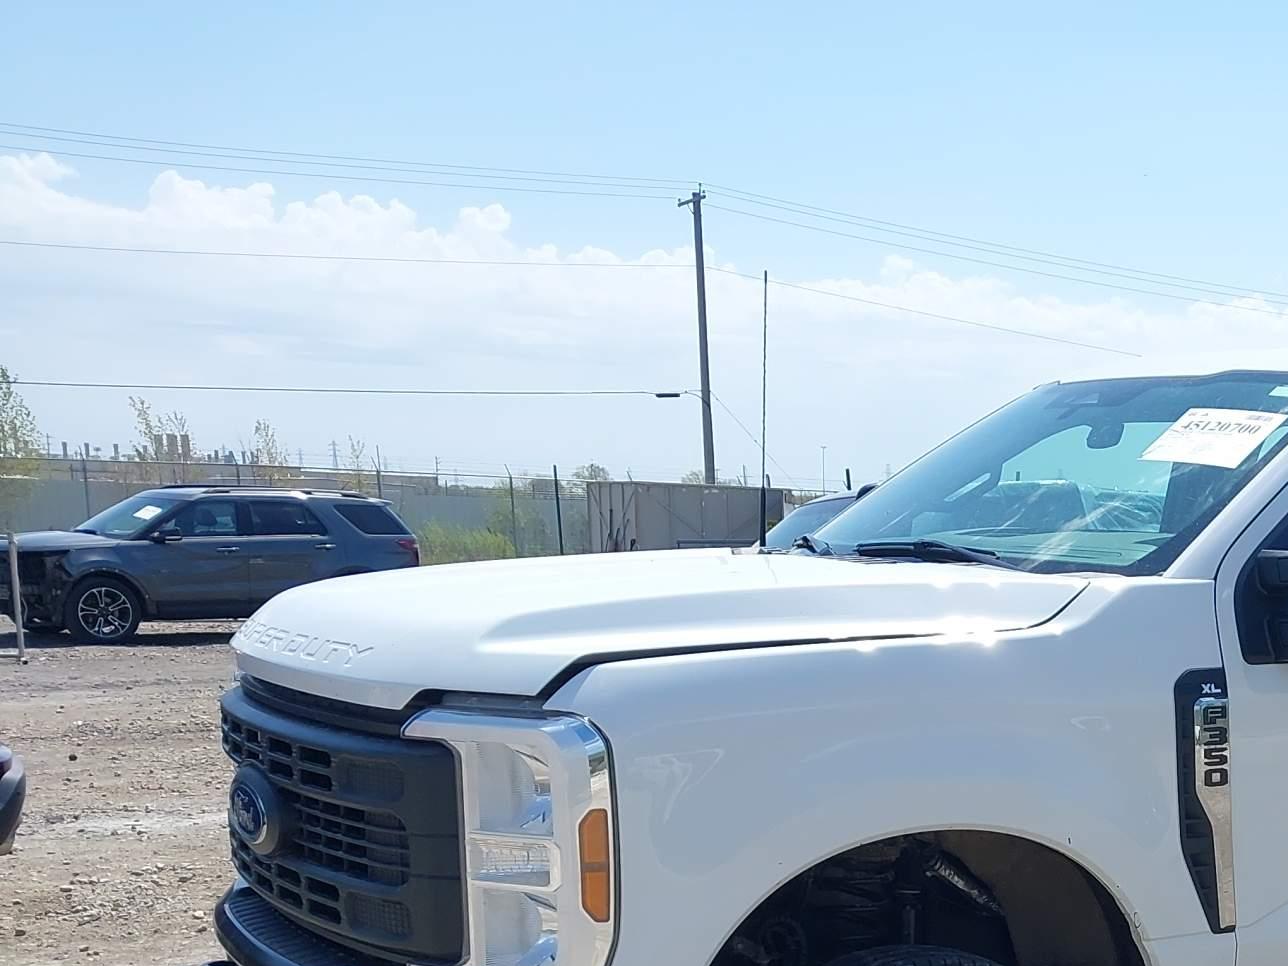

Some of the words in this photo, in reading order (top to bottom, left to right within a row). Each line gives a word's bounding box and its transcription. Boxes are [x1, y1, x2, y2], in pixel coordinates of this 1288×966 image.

[1181, 419, 1262, 435] 45120700
[281, 633, 375, 667] DUTY
[1201, 683, 1222, 694] XL
